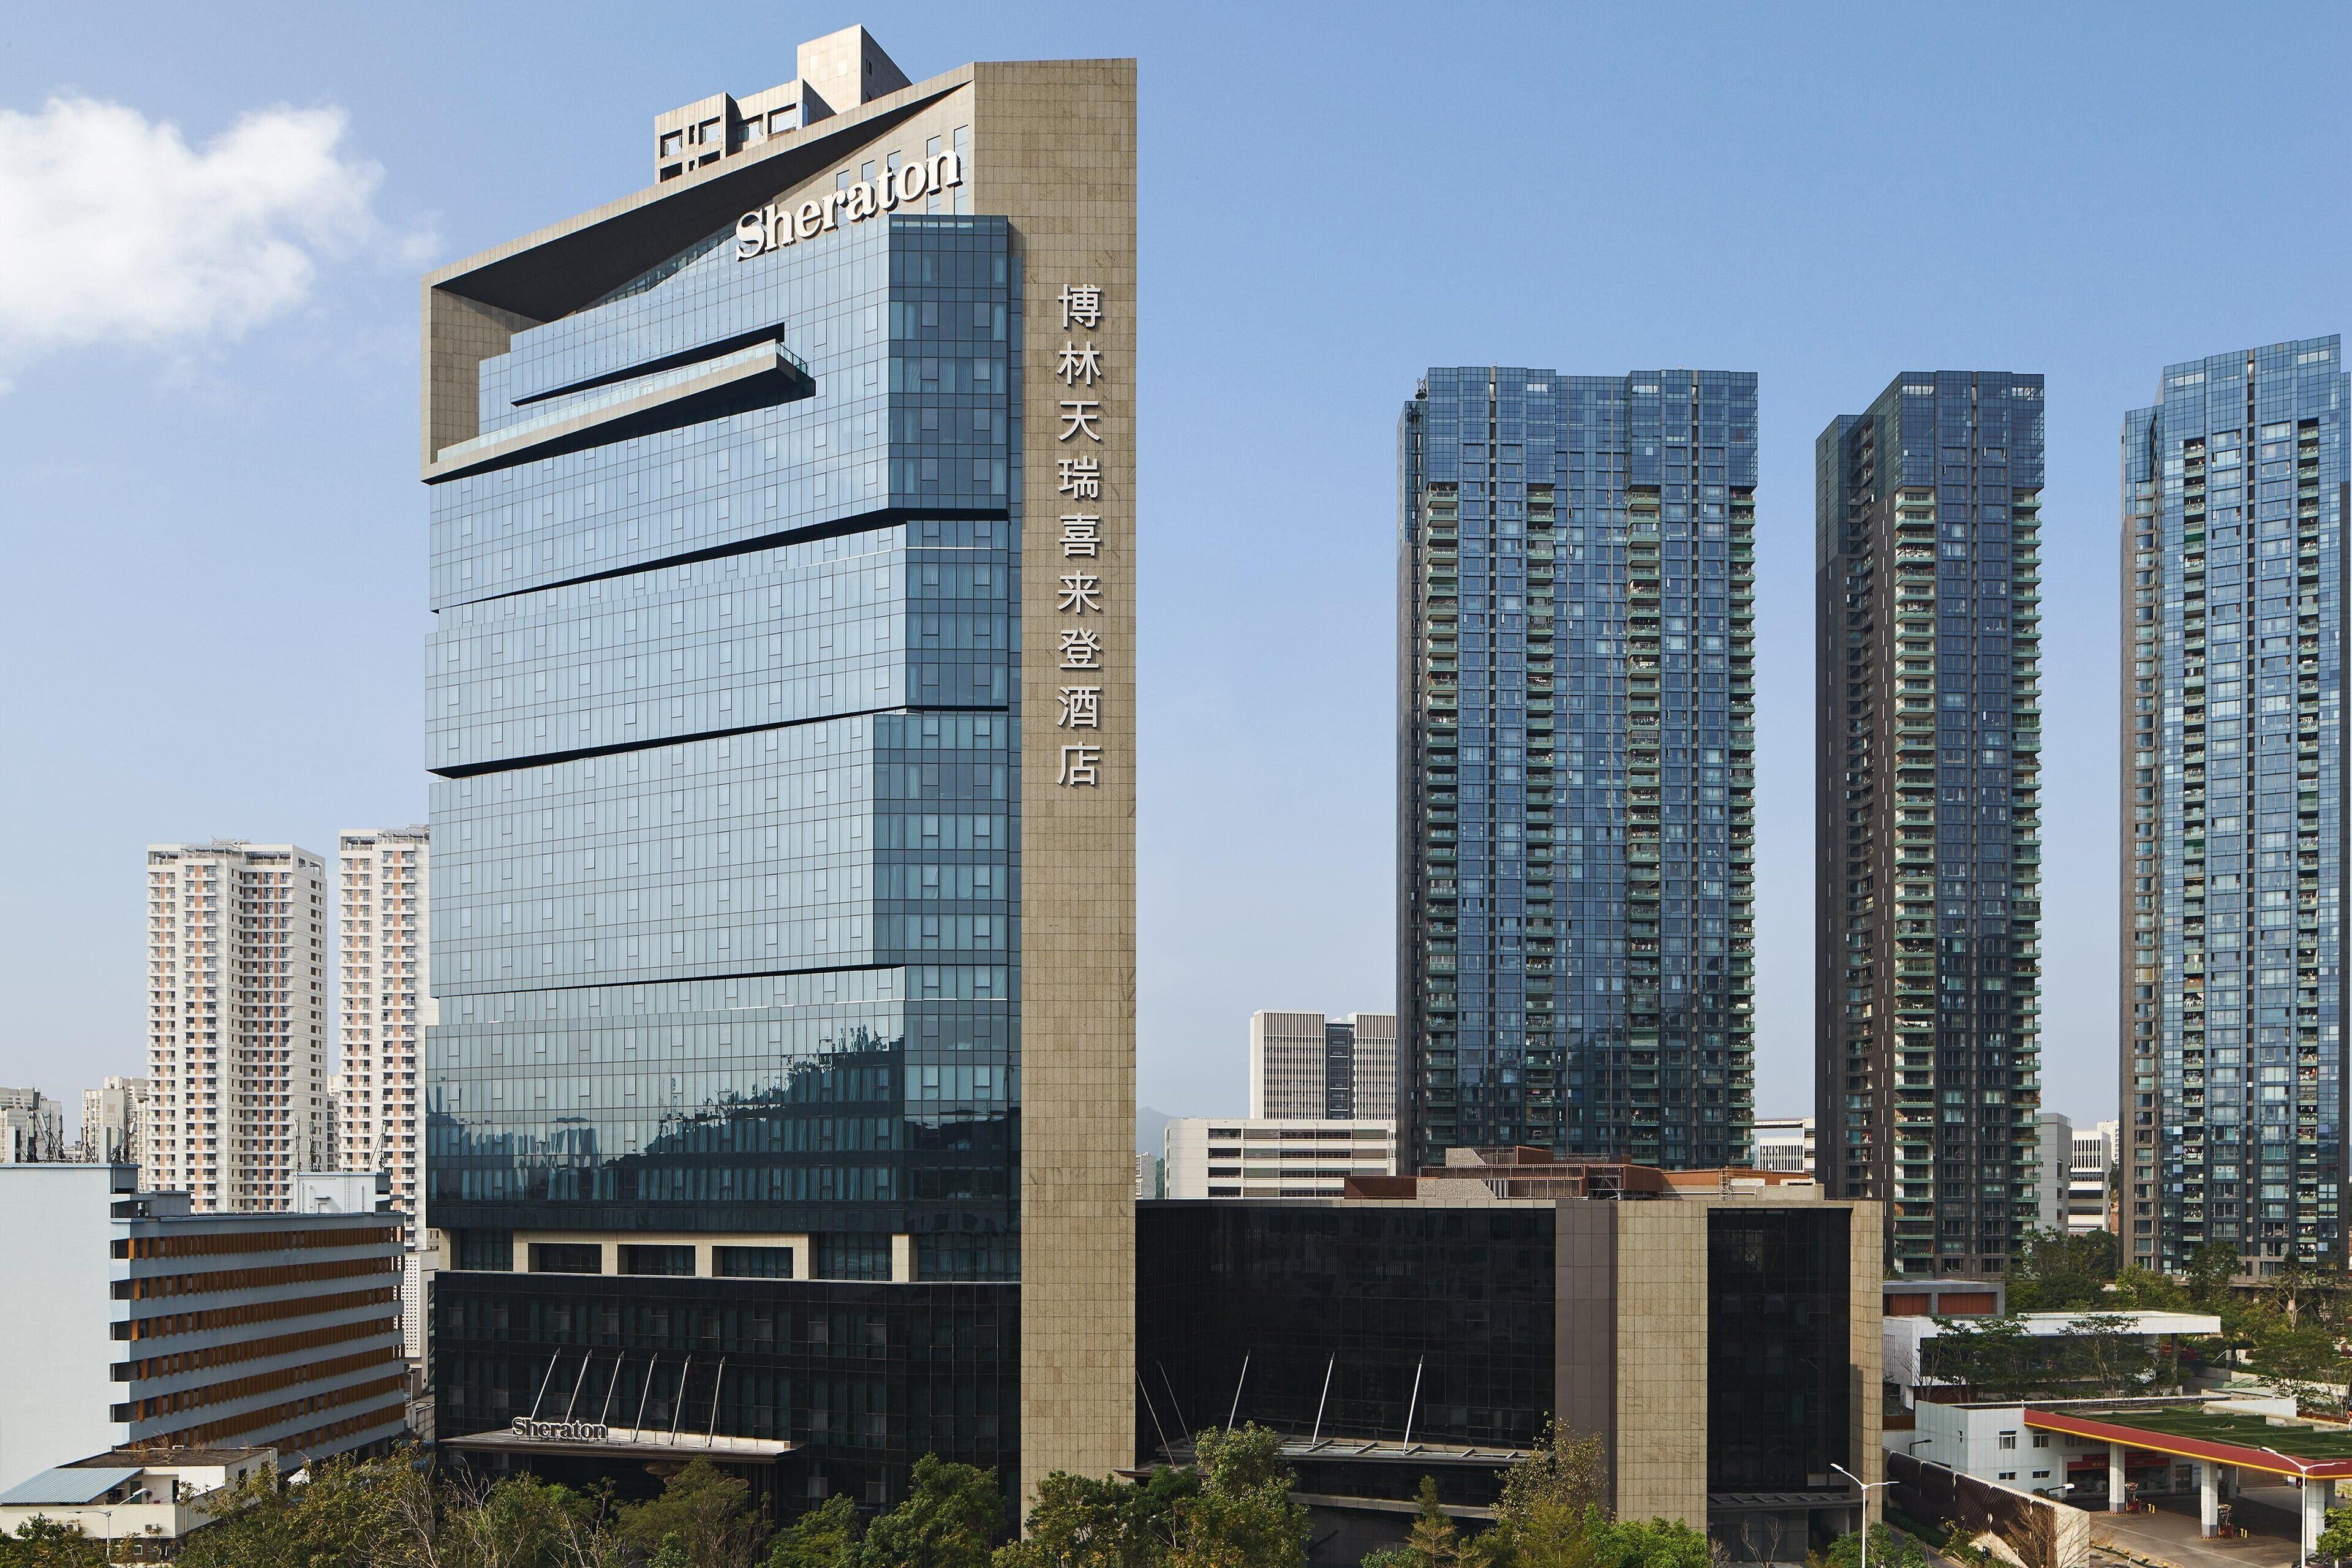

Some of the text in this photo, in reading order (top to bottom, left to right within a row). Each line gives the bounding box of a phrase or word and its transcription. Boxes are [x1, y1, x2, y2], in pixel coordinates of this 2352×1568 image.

[736, 149, 963, 262] Sheraton
[1057, 283, 1102, 785] 博林天瑞喜来登酒店
[512, 1416, 608, 1439] Sheraton
